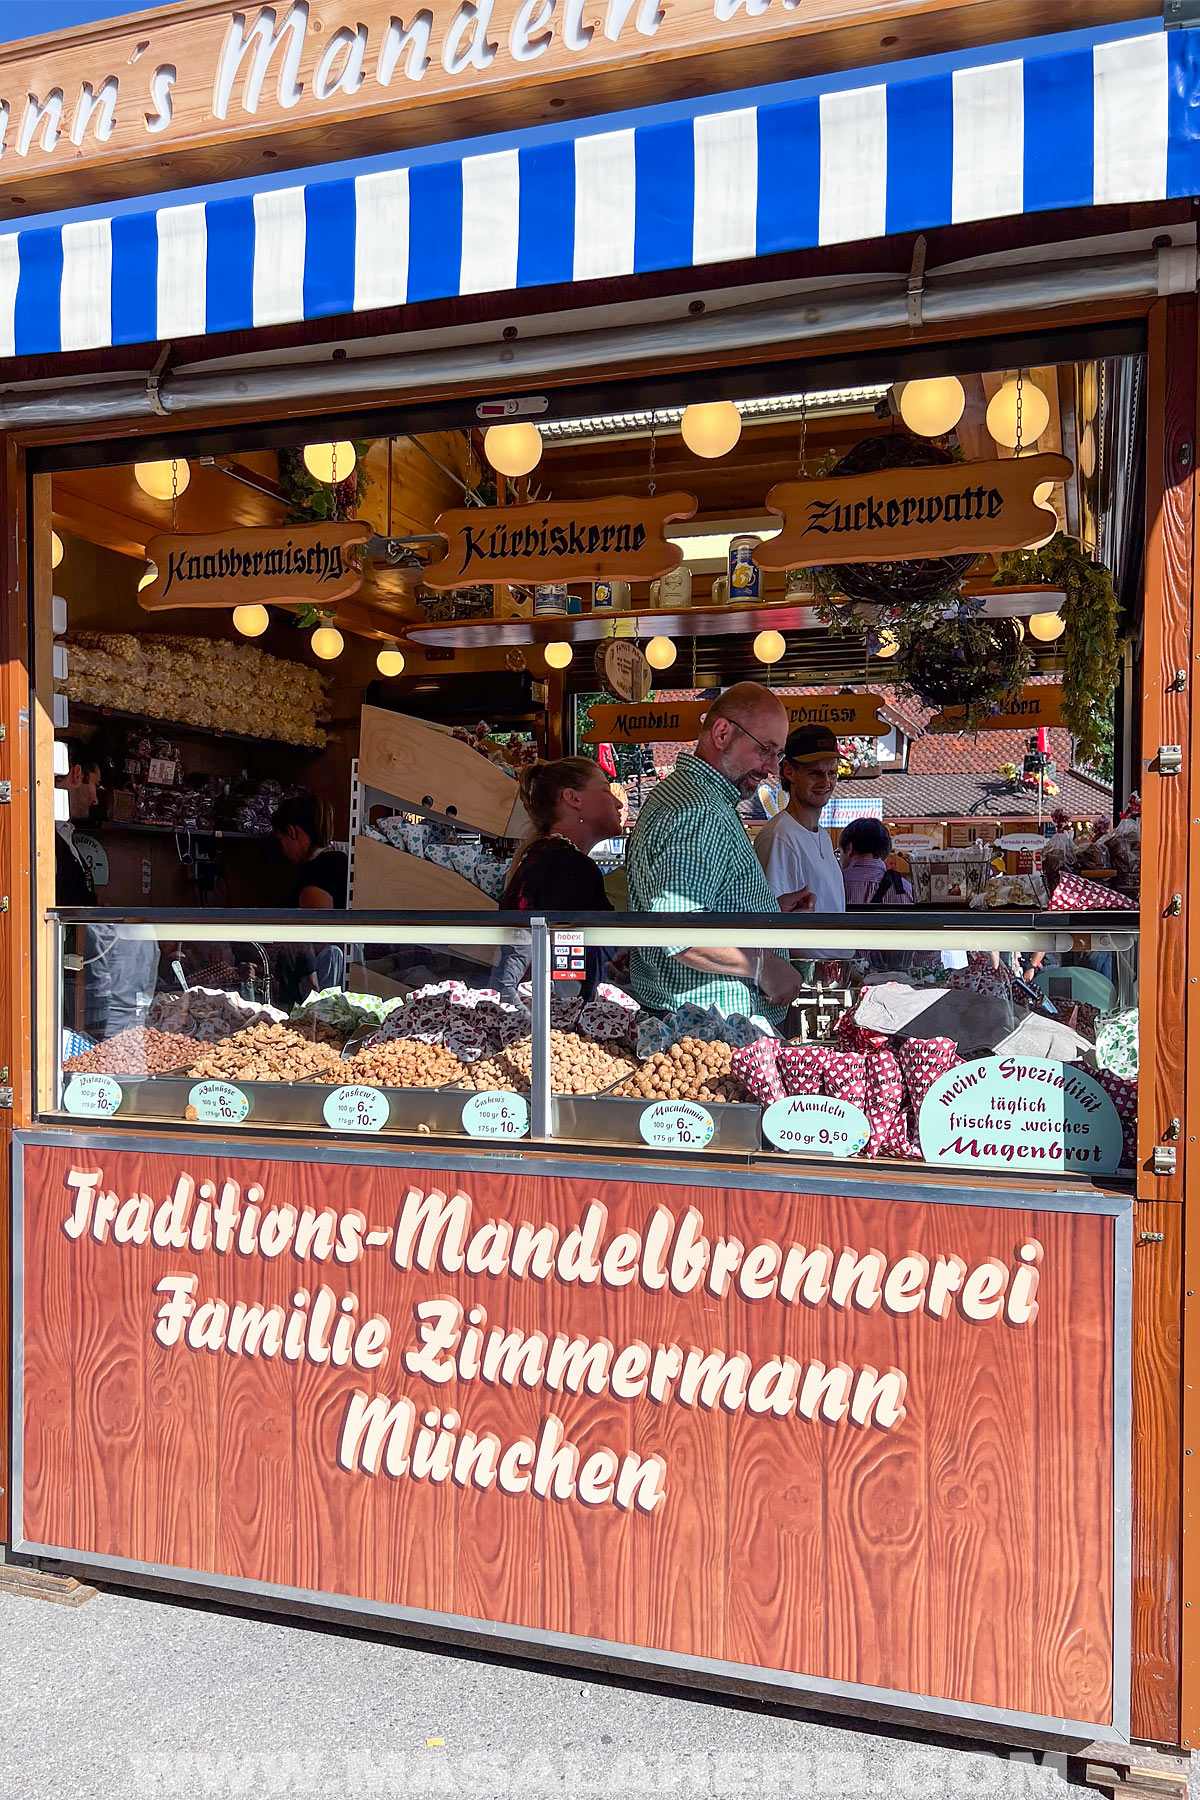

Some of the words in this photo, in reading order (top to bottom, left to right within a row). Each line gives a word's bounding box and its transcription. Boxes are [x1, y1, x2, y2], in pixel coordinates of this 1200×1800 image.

[212, 0, 666, 120] Mandeln
[800, 484, 1005, 537] Zuckerwatte
[458, 518, 648, 576] Kürbiskerne
[608, 710, 680, 737] Mandeln
[785, 703, 857, 723] rdnüsse
[938, 1066, 987, 1107] meine
[998, 1058, 1103, 1113] Spezialität
[651, 1104, 704, 1121] Macadamia
[787, 1100, 846, 1119] Mandeln
[990, 1096, 1046, 1115] täglich
[357, 1114, 377, 1126] 10.-
[500, 1121, 520, 1133] 10.-
[949, 1113, 1012, 1131] frisches
[677, 1130, 701, 1143] 10.-
[779, 1129, 802, 1141] 200
[803, 1134, 816, 1144] gr
[938, 1136, 1102, 1162] Magenbrot
[63, 1166, 1043, 1328] Traditions-Mandelbrennerei
[154, 1272, 391, 1370] Familie
[404, 1297, 909, 1430] Zimmermann
[338, 1390, 667, 1514] München
